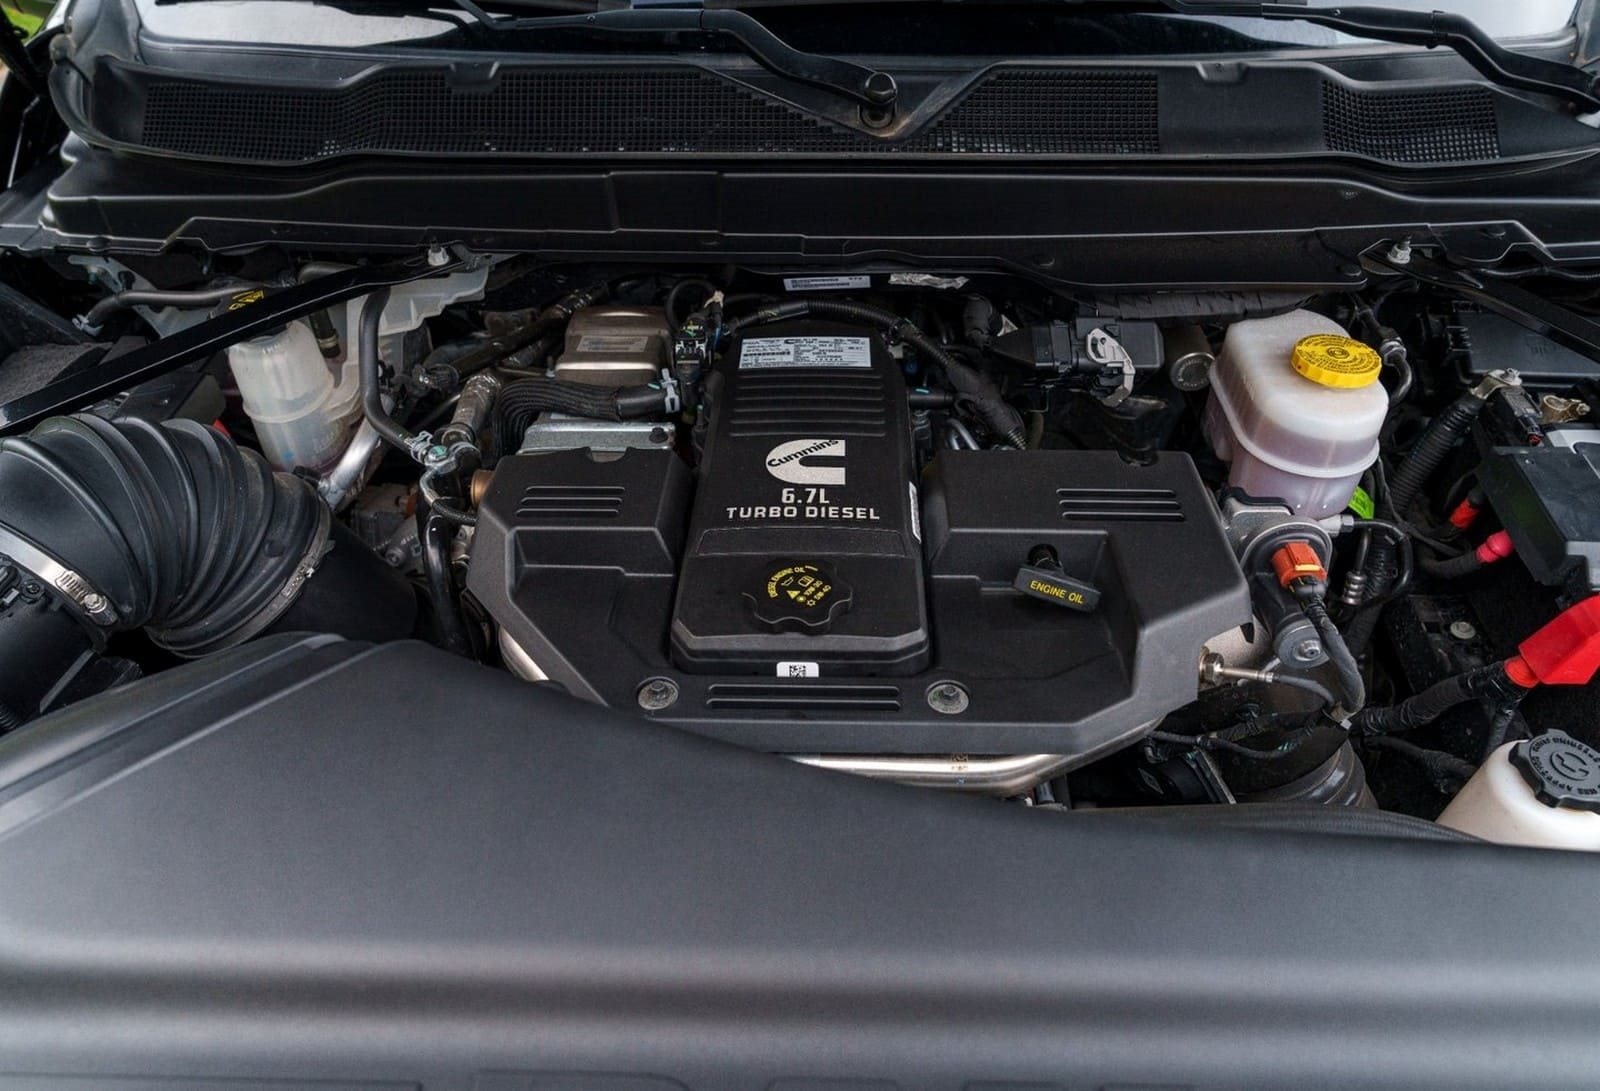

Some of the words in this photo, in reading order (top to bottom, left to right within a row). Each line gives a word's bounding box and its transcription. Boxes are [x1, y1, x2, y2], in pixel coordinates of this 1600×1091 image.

[767, 439, 839, 467] Cummins
[781, 488, 830, 503] 6.7L
[726, 506, 797, 519] TURBO
[805, 506, 880, 520] DIESEL
[1030, 580, 1066, 599] ENGINE
[1068, 592, 1084, 604] OIL
